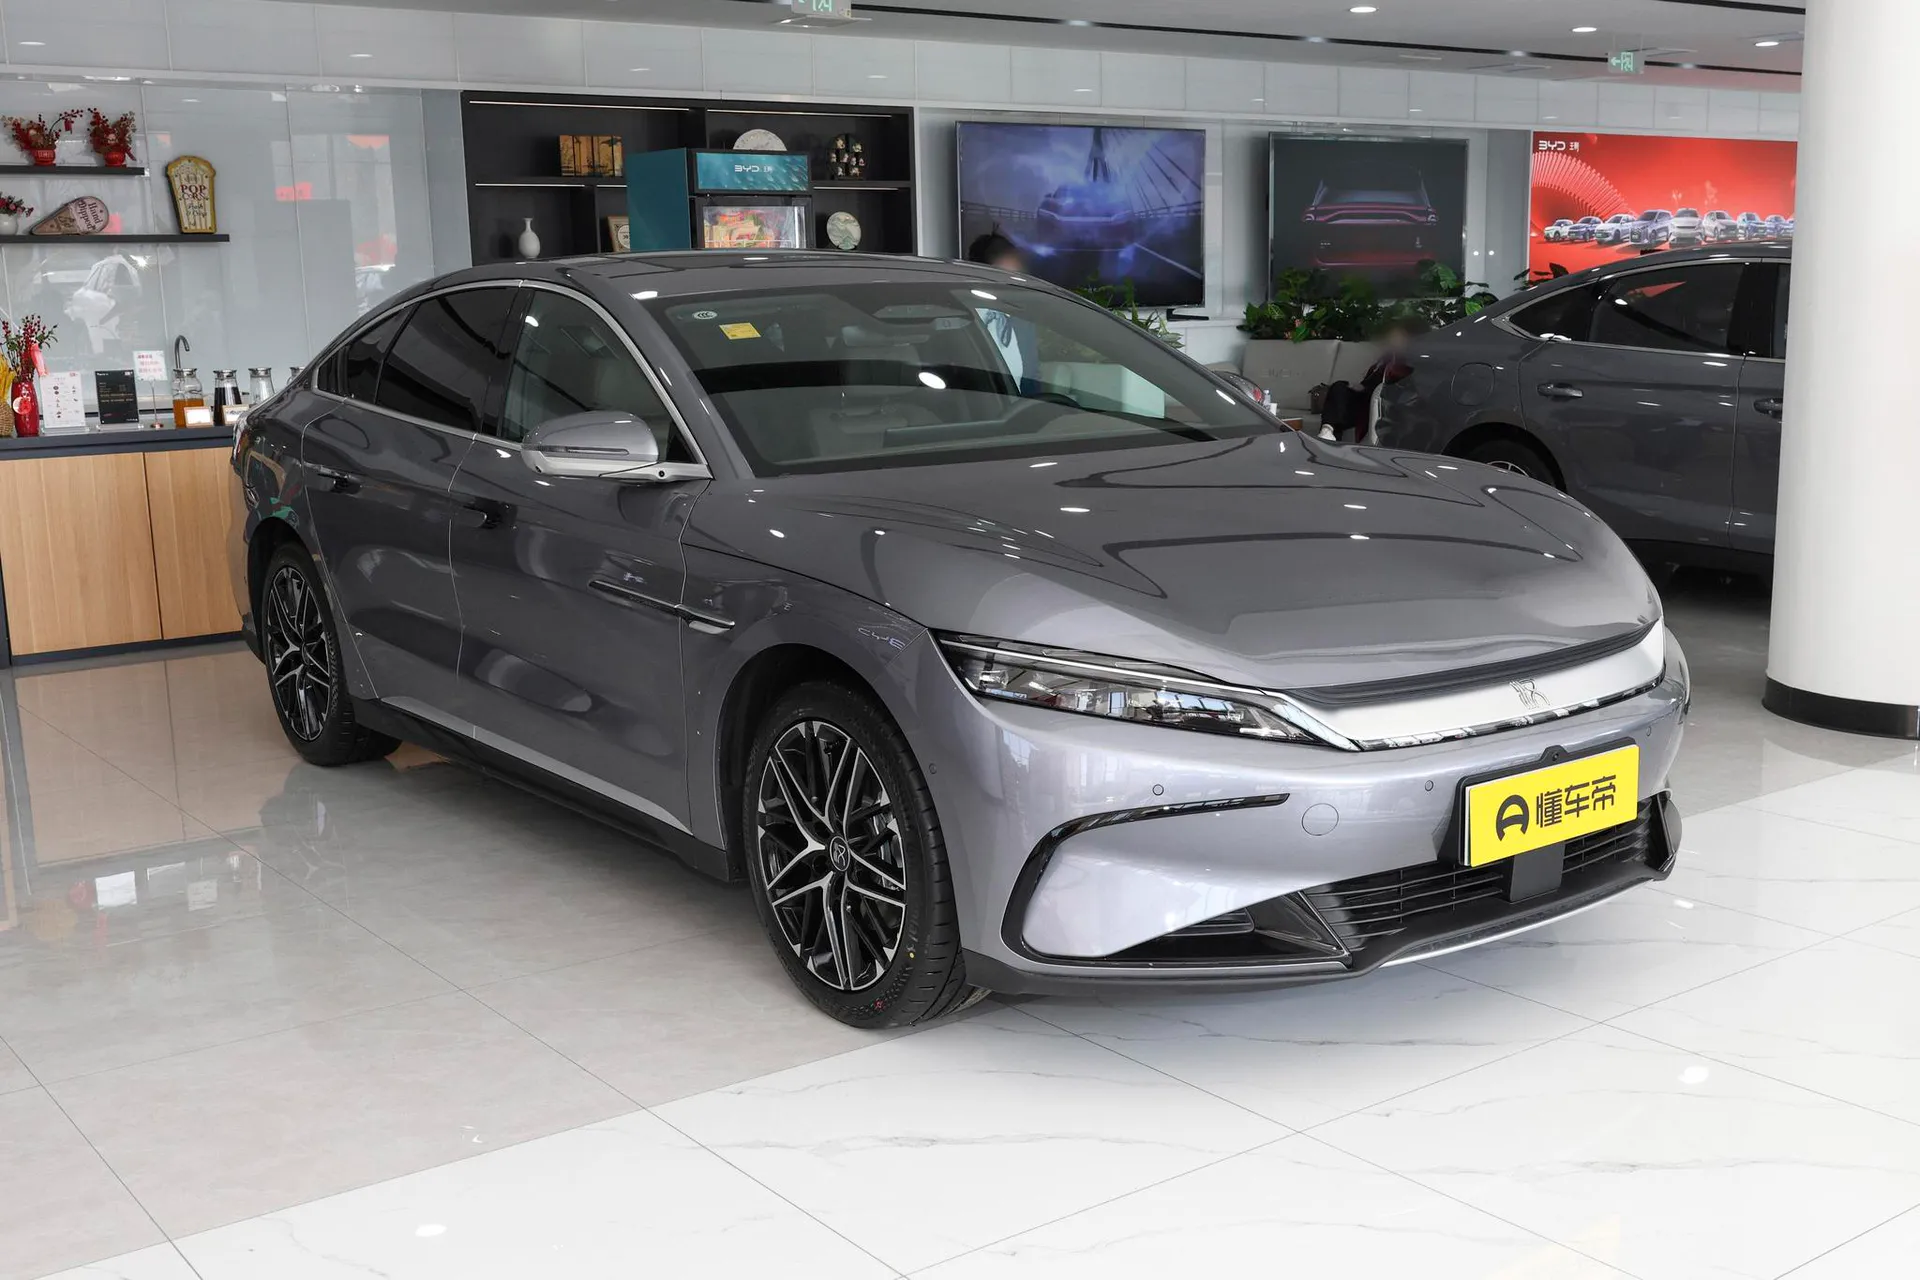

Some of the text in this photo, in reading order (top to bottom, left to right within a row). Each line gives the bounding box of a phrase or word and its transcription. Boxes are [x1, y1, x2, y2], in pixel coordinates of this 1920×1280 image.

[1538, 140, 1566, 151] BYD
[734, 164, 760, 173] BYD
[180, 184, 207, 193] POP
[78, 201, 95, 230] Dipped
[88, 202, 104, 224] Hand
[1536, 774, 1616, 828] 懂车帝
